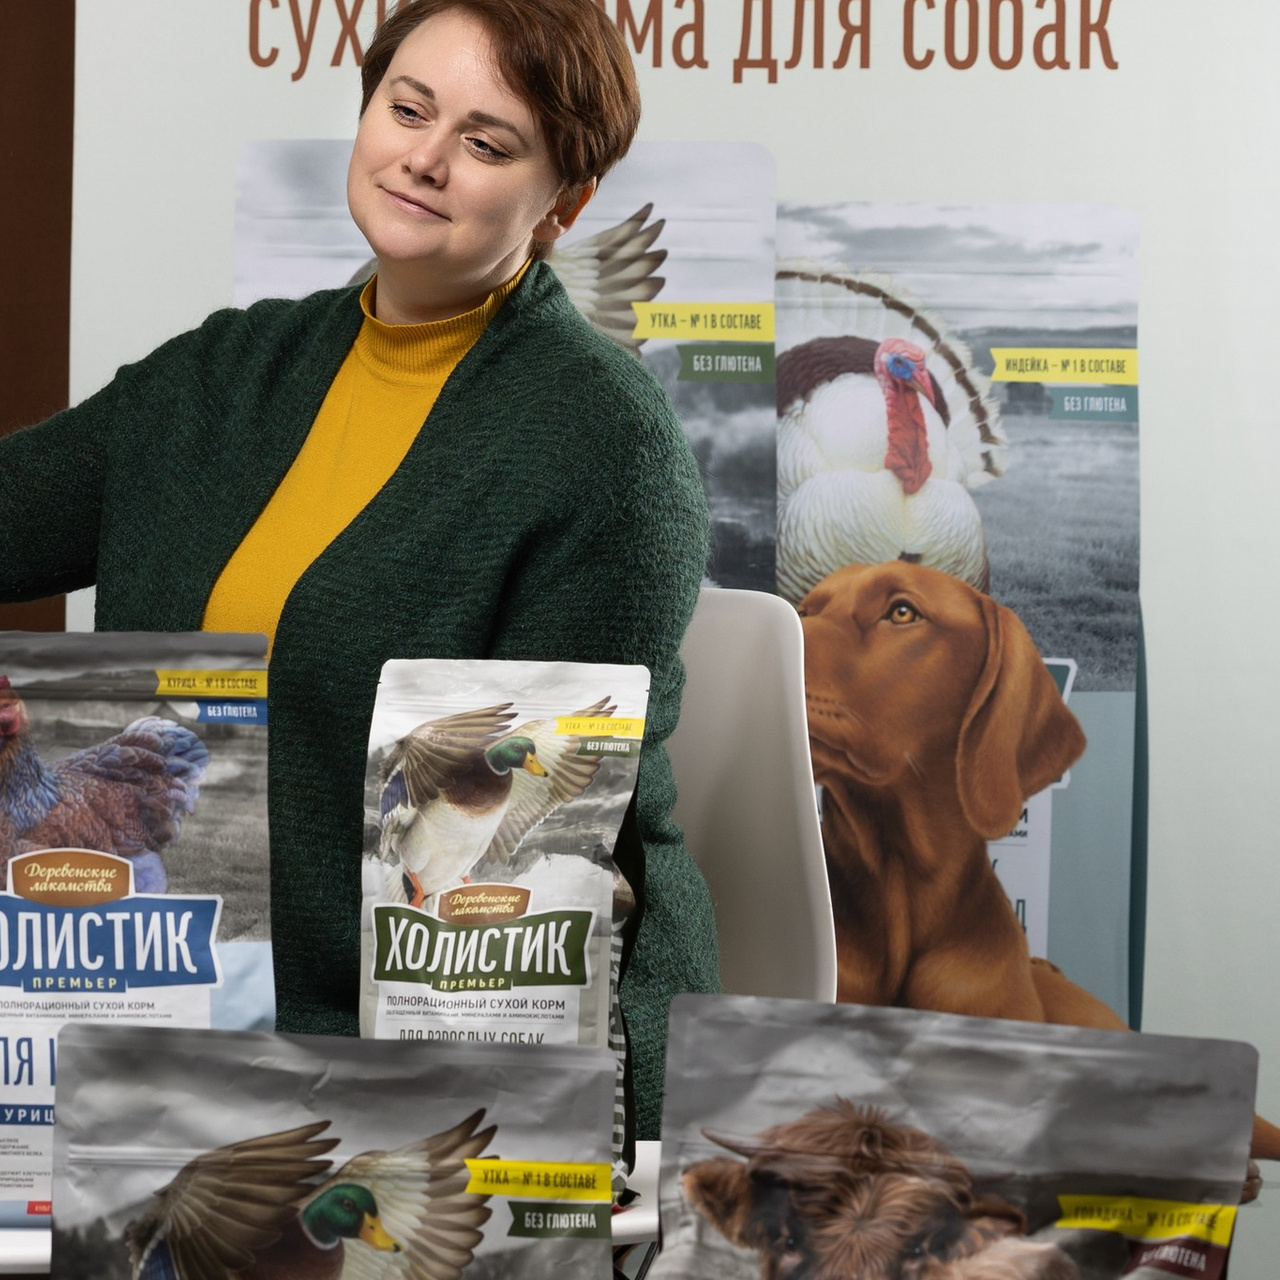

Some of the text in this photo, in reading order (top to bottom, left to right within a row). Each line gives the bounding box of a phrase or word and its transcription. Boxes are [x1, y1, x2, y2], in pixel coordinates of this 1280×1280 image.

[650, 313, 677, 328] УТКА
[711, 314, 717, 329] В
[720, 314, 762, 329] СОСТАВЕ
[693, 355, 762, 372] БЕЗ ГЛЮТЕНА
[1005, 357, 1049, 373] ИНДЕЙКА
[1080, 359, 1086, 372] В
[1089, 359, 1126, 373] СОСТАВЕ
[1064, 396, 1127, 412] БЕЗ ГЛЮТЕНА
[167, 677, 197, 689] КУРИЦА
[227, 678, 258, 689] СОСТАВЕ
[207, 705, 257, 717] БЕЗ ГЛЮТЕНА
[586, 741, 630, 752] БЕЗ ГЛЮТЕНА
[24, 861, 117, 884] Деревенские
[30, 877, 113, 895] лакомства
[449, 893, 521, 907] Деревенские
[451, 904, 514, 916] лакомства
[385, 916, 572, 976] ХОЛИСТИК
[32, 976, 119, 990] ПРЕМЬЕР
[439, 977, 505, 990] ПРЕМЬЕР
[93, 1001, 124, 1011] СУХОЙ
[127, 1001, 155, 1010] КОРМ
[387, 995, 565, 1010] ПОЛНОРАЦИОННЫЙ СУХОЙ КОРМ
[483, 1169, 509, 1184] УТКА
[544, 1173, 550, 1187] В
[553, 1173, 597, 1189] СОСТАВЕ
[525, 1212, 597, 1229] БЕЗ ГЛЮТЕНА
